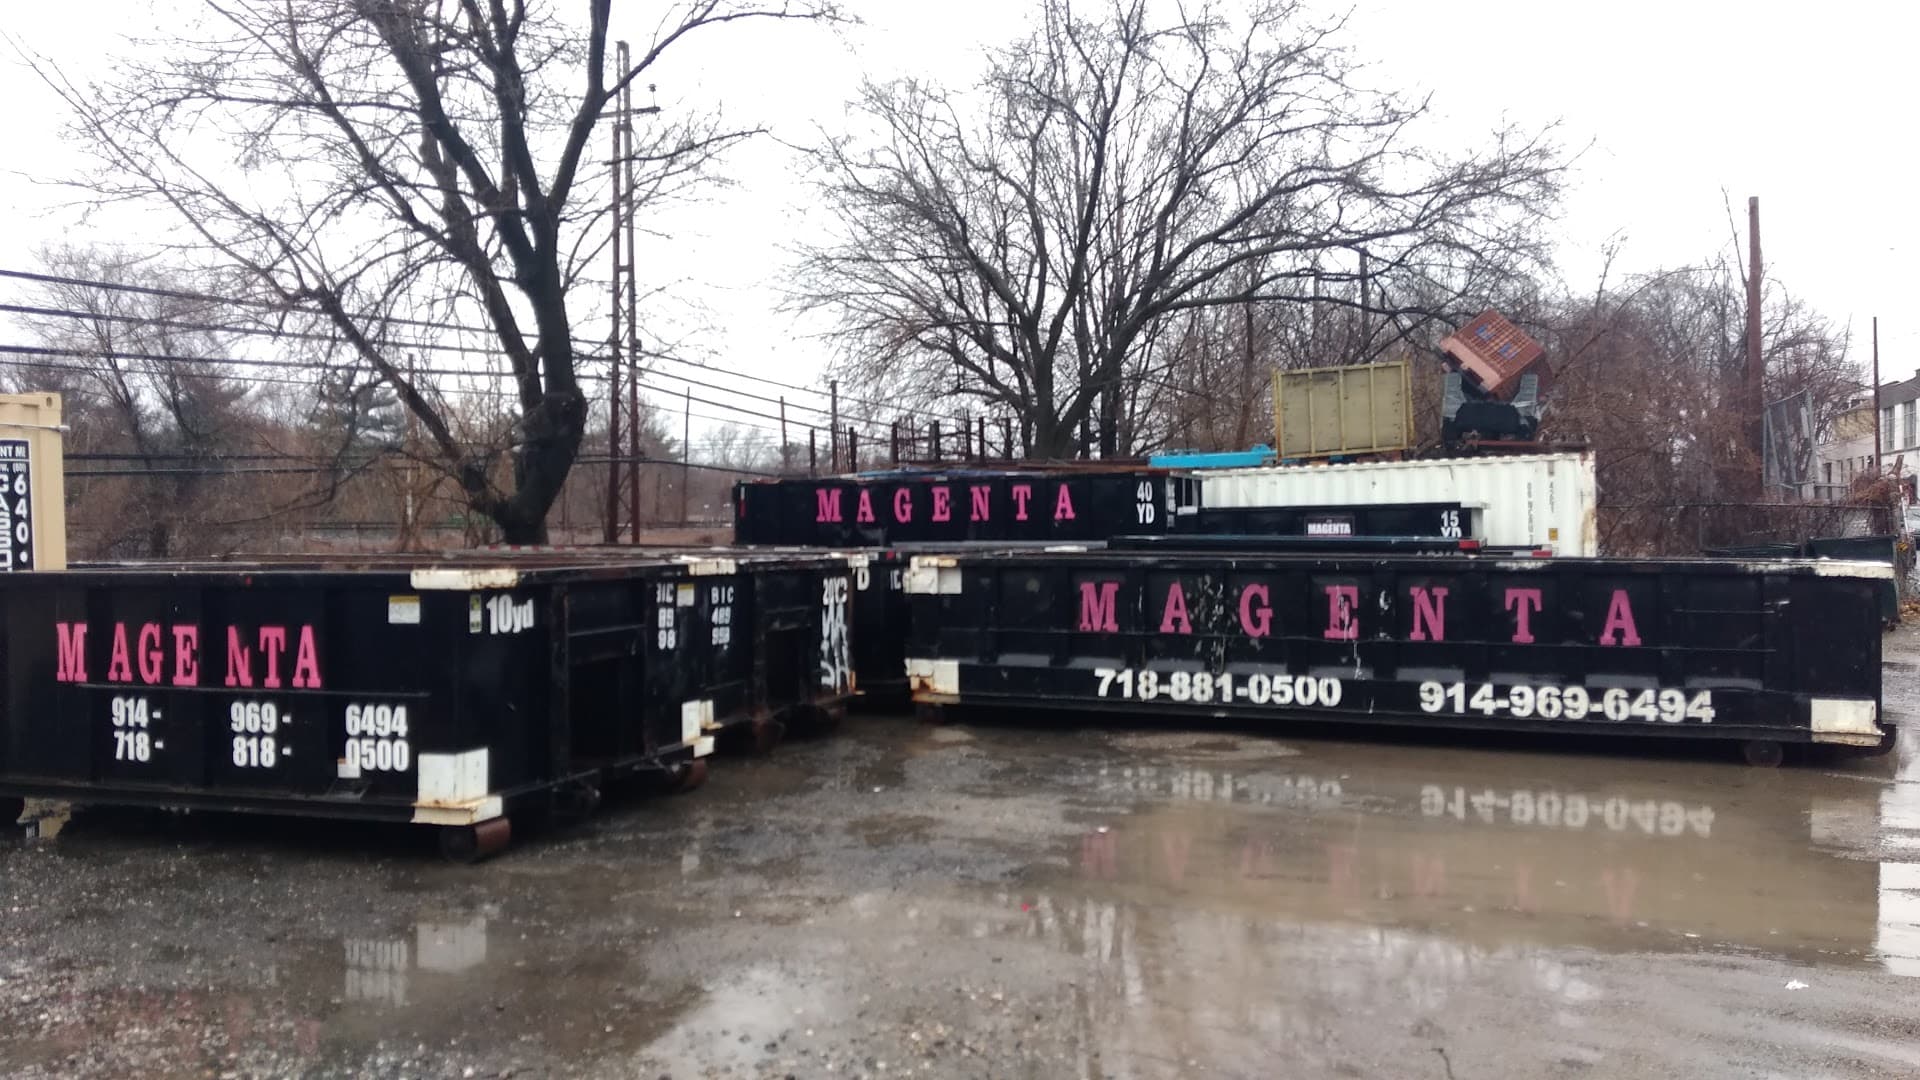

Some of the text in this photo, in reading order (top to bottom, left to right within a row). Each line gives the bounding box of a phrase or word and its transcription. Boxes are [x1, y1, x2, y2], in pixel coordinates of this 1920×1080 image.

[816, 484, 1075, 523] MAGENTA
[1136, 481, 1153, 502] 40
[1136, 503, 1155, 524] YD
[1307, 523, 1351, 535] MAGENTA
[1440, 510, 1459, 528] 15
[711, 586, 734, 604] BIC
[487, 595, 535, 635] 10yd
[1079, 581, 1642, 647] MAGENTA
[56, 622, 321, 688] MAGENTA
[1094, 668, 1716, 724] 718-881-0500 914-969-6494
[345, 705, 408, 737] 6494
[345, 739, 409, 772] 0500
